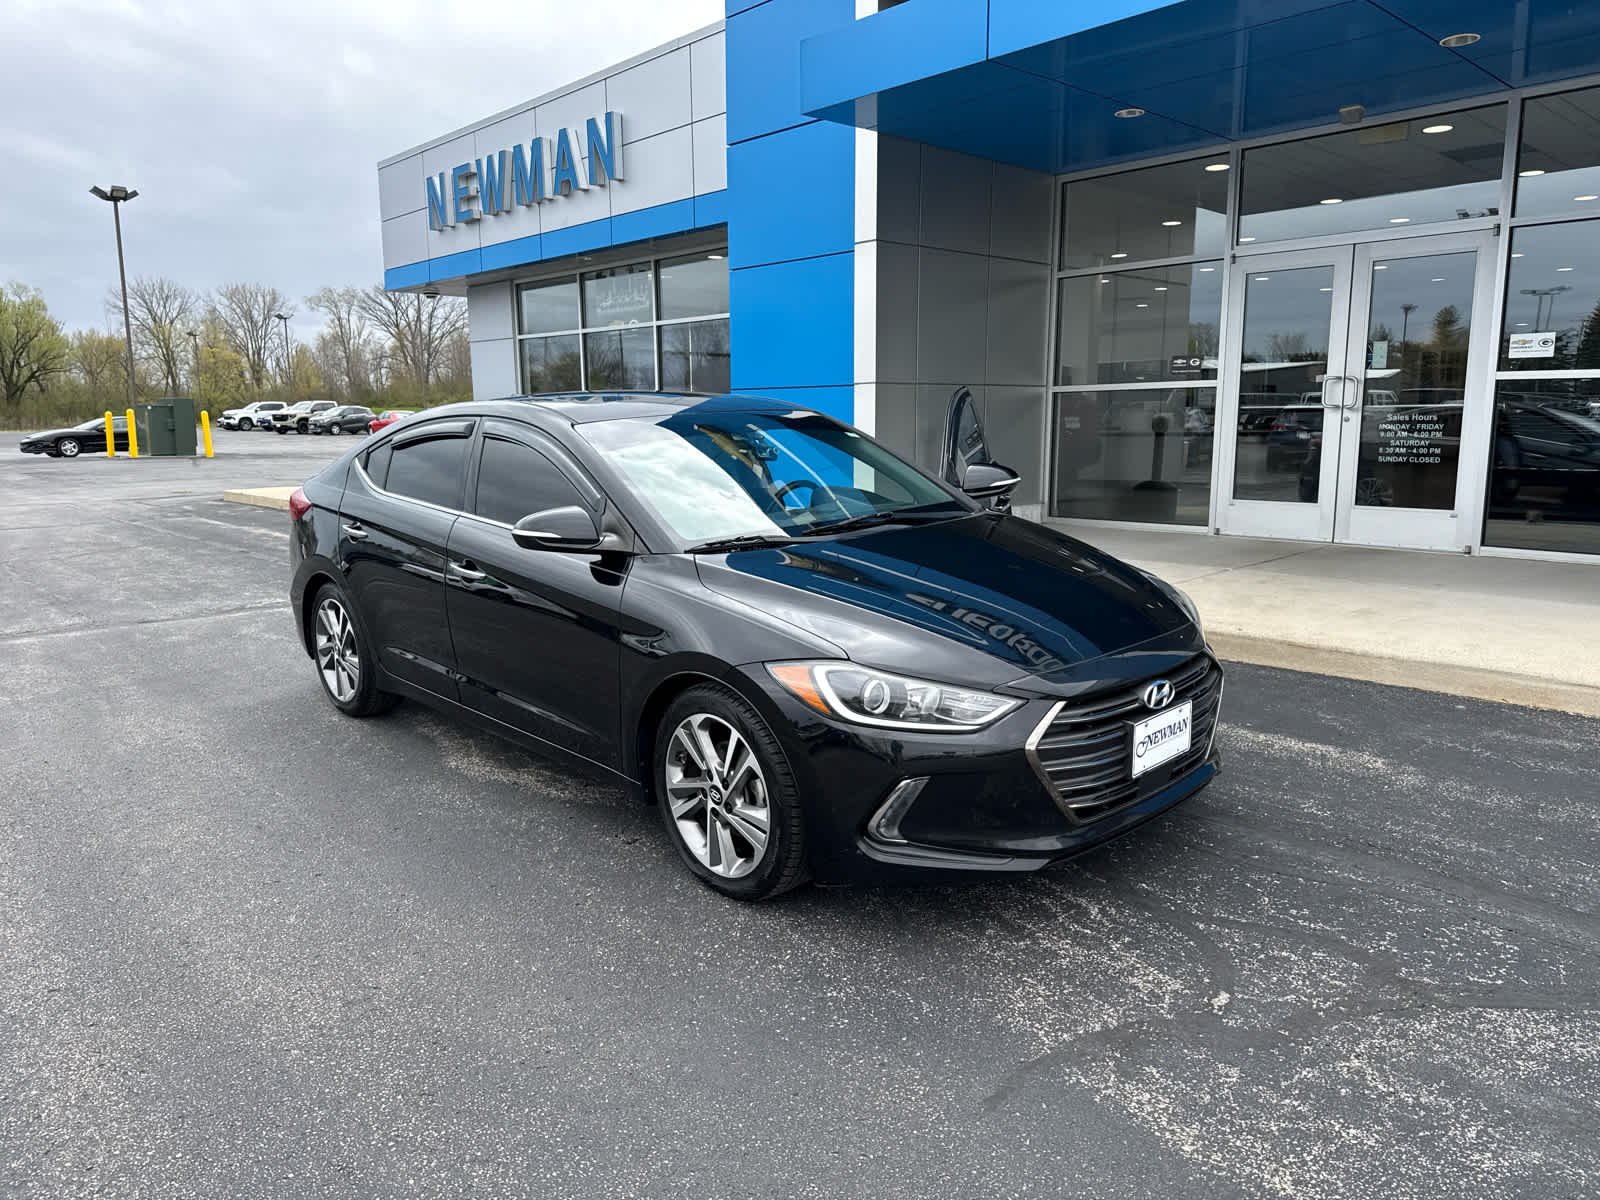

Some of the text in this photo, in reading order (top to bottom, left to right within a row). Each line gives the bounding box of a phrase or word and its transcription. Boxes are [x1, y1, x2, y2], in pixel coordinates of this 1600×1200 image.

[426, 111, 623, 231] NEWMAN
[1386, 413, 1438, 421] Sales Hours
[1390, 439, 1430, 447] SATURDAY
[1429, 447, 1441, 455] PM
[1378, 455, 1441, 464] SUNDAY CLOSED
[1136, 717, 1189, 758] NEWMAN
